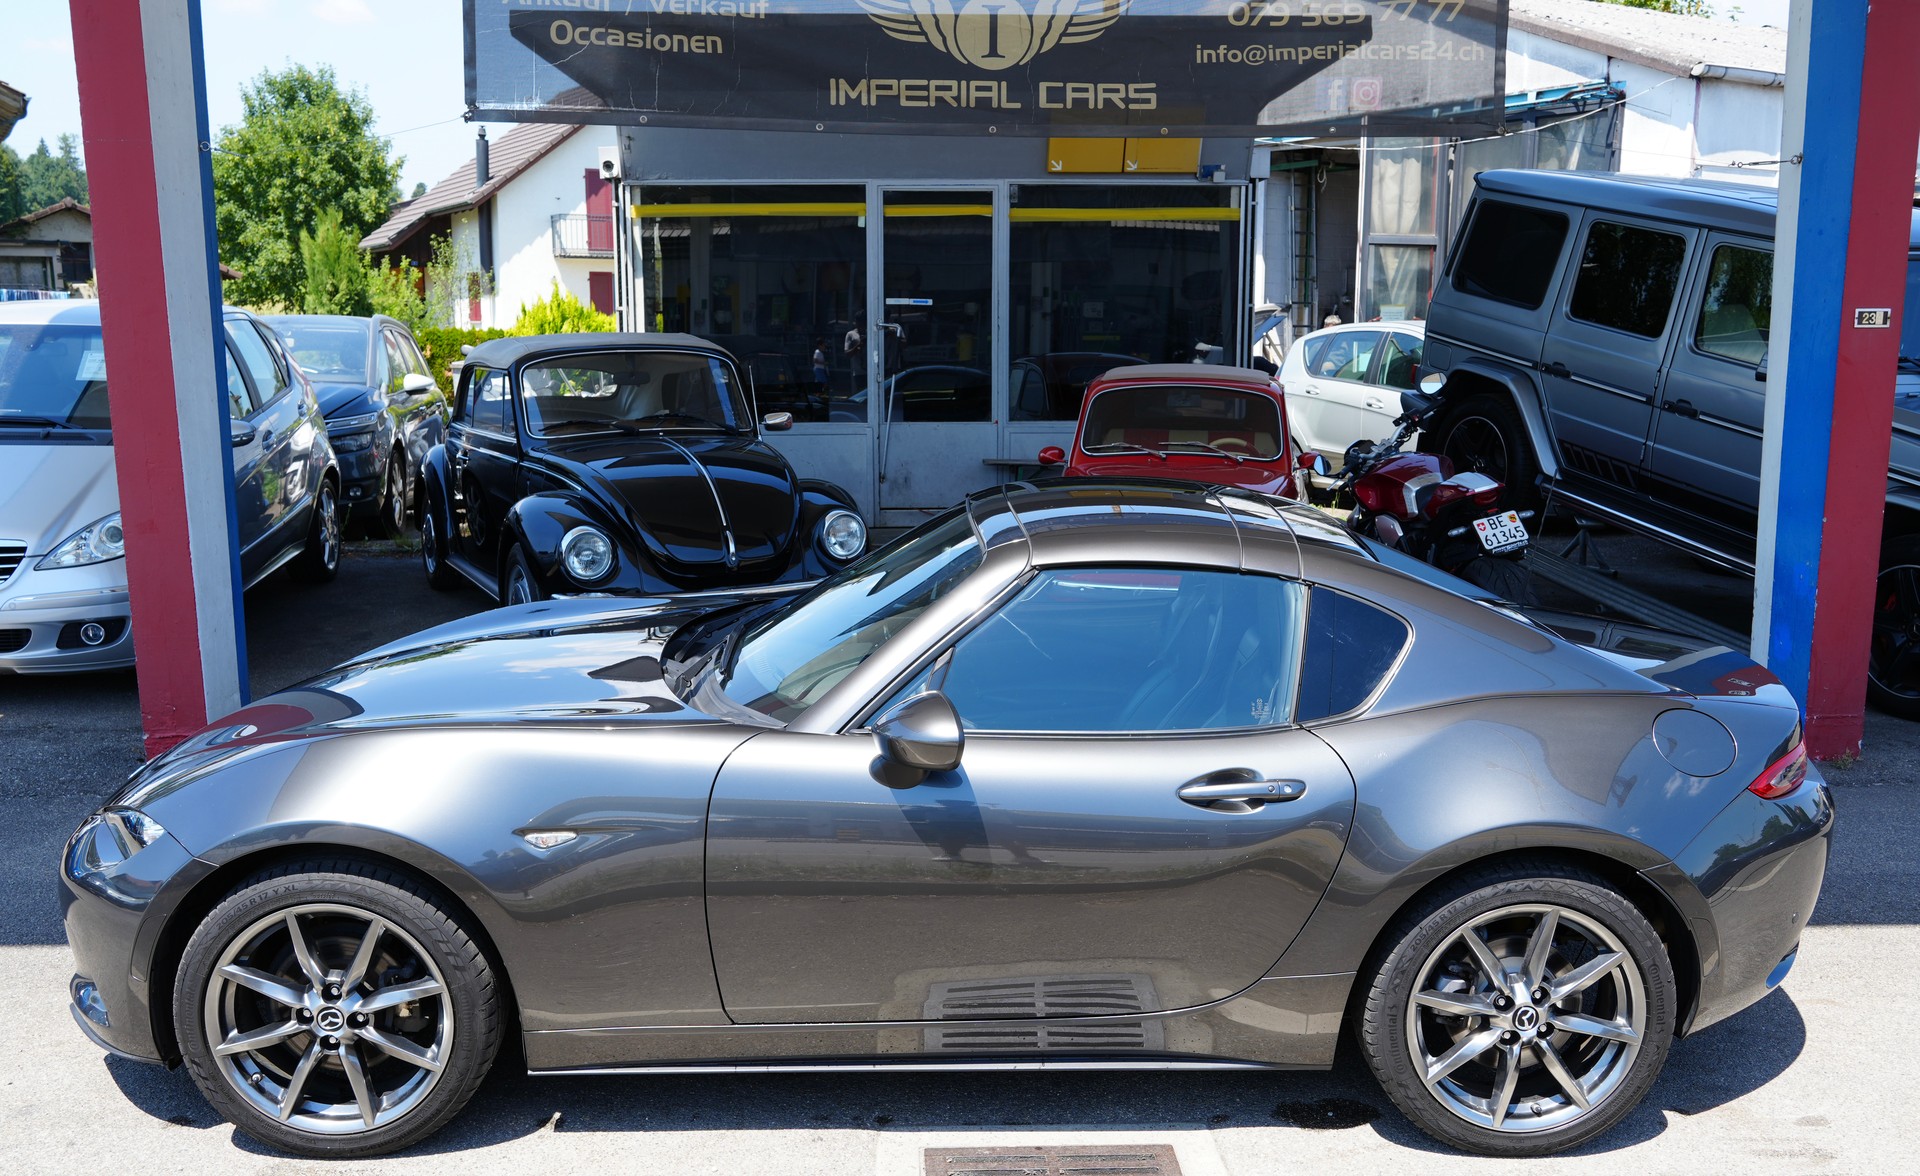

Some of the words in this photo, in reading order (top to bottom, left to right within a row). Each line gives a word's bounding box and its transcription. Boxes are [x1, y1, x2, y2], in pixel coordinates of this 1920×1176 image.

[1227, 2, 1290, 27] 079
[1301, 2, 1366, 27] 569
[1376, 0, 1418, 21] 77
[1427, 0, 1465, 22] 77
[550, 19, 723, 54] Occasionen
[1196, 39, 1485, 66] info@imperialcars24.ch
[829, 78, 1022, 109] IMPERIAL
[1038, 81, 1157, 110] CARS
[1862, 312, 1876, 324] 23
[1484, 525, 1525, 547] 61345
[1487, 515, 1507, 530] BE
[216, 903, 249, 929] 205/45
[249, 898, 257, 906] R
[258, 892, 268, 901] 17
[283, 884, 299, 893] XL
[1409, 919, 1440, 952] 205/45
[1439, 913, 1448, 921] R
[1470, 892, 1486, 903] XL
[1648, 963, 1666, 1026] Continental
[1386, 1013, 1406, 1075] Continental
